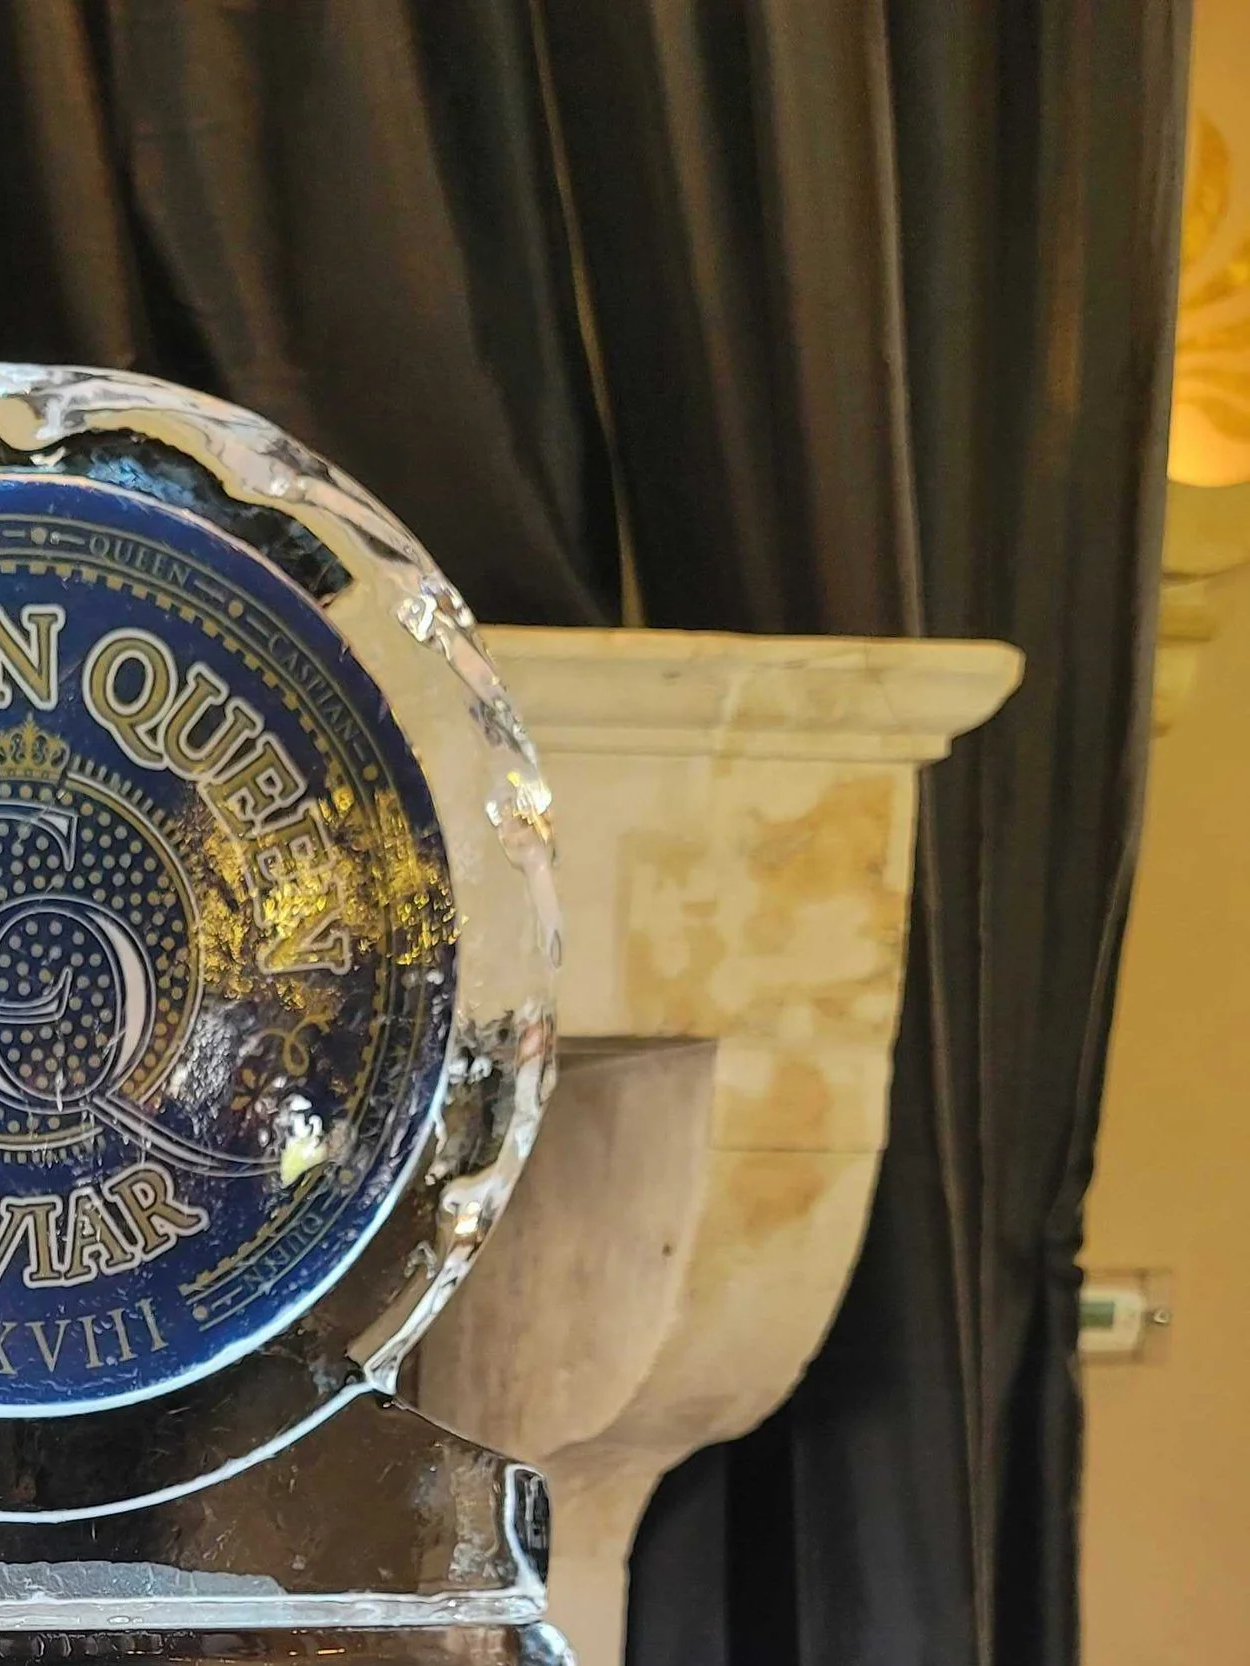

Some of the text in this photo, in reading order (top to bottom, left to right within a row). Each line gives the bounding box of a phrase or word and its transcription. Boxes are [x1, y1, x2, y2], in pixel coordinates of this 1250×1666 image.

[88, 533, 193, 589] QUEEN
[268, 630, 361, 743] CASPIAN
[82, 627, 351, 976] QUEEN
